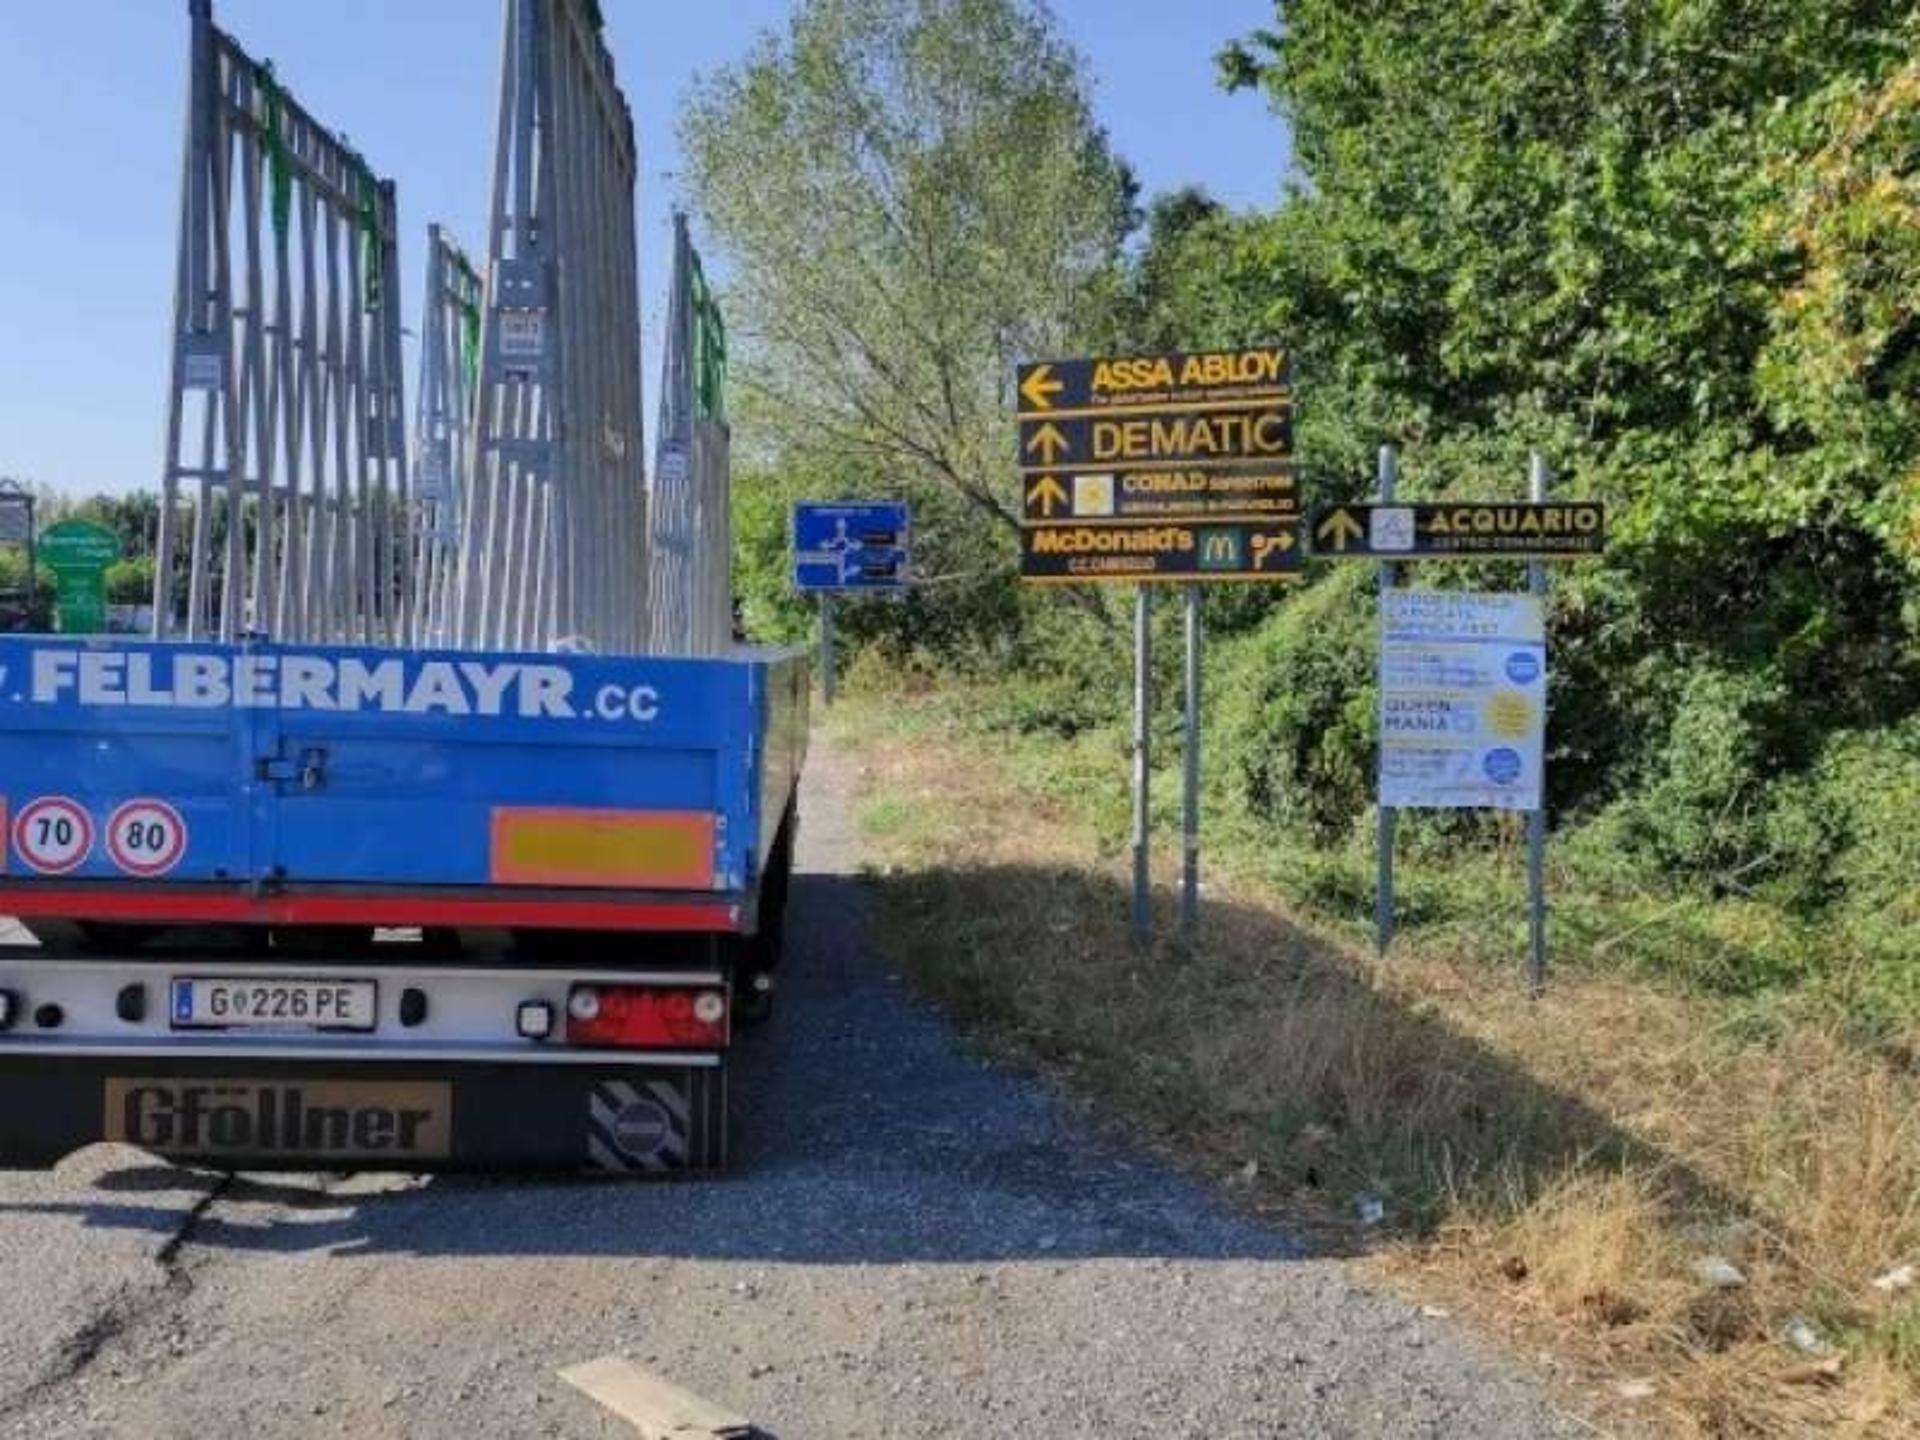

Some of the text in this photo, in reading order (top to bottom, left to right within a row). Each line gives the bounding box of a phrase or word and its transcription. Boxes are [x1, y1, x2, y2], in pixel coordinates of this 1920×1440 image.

[1092, 349, 1285, 391] ASSA ABLOY
[1093, 413, 1285, 459] DEMATIC
[1429, 507, 1599, 533] ACQUARIO
[1032, 527, 1195, 554] McDonald's
[36, 817, 72, 846] 70
[126, 822, 165, 851] 80
[129, 1086, 434, 1151] Gföllner
